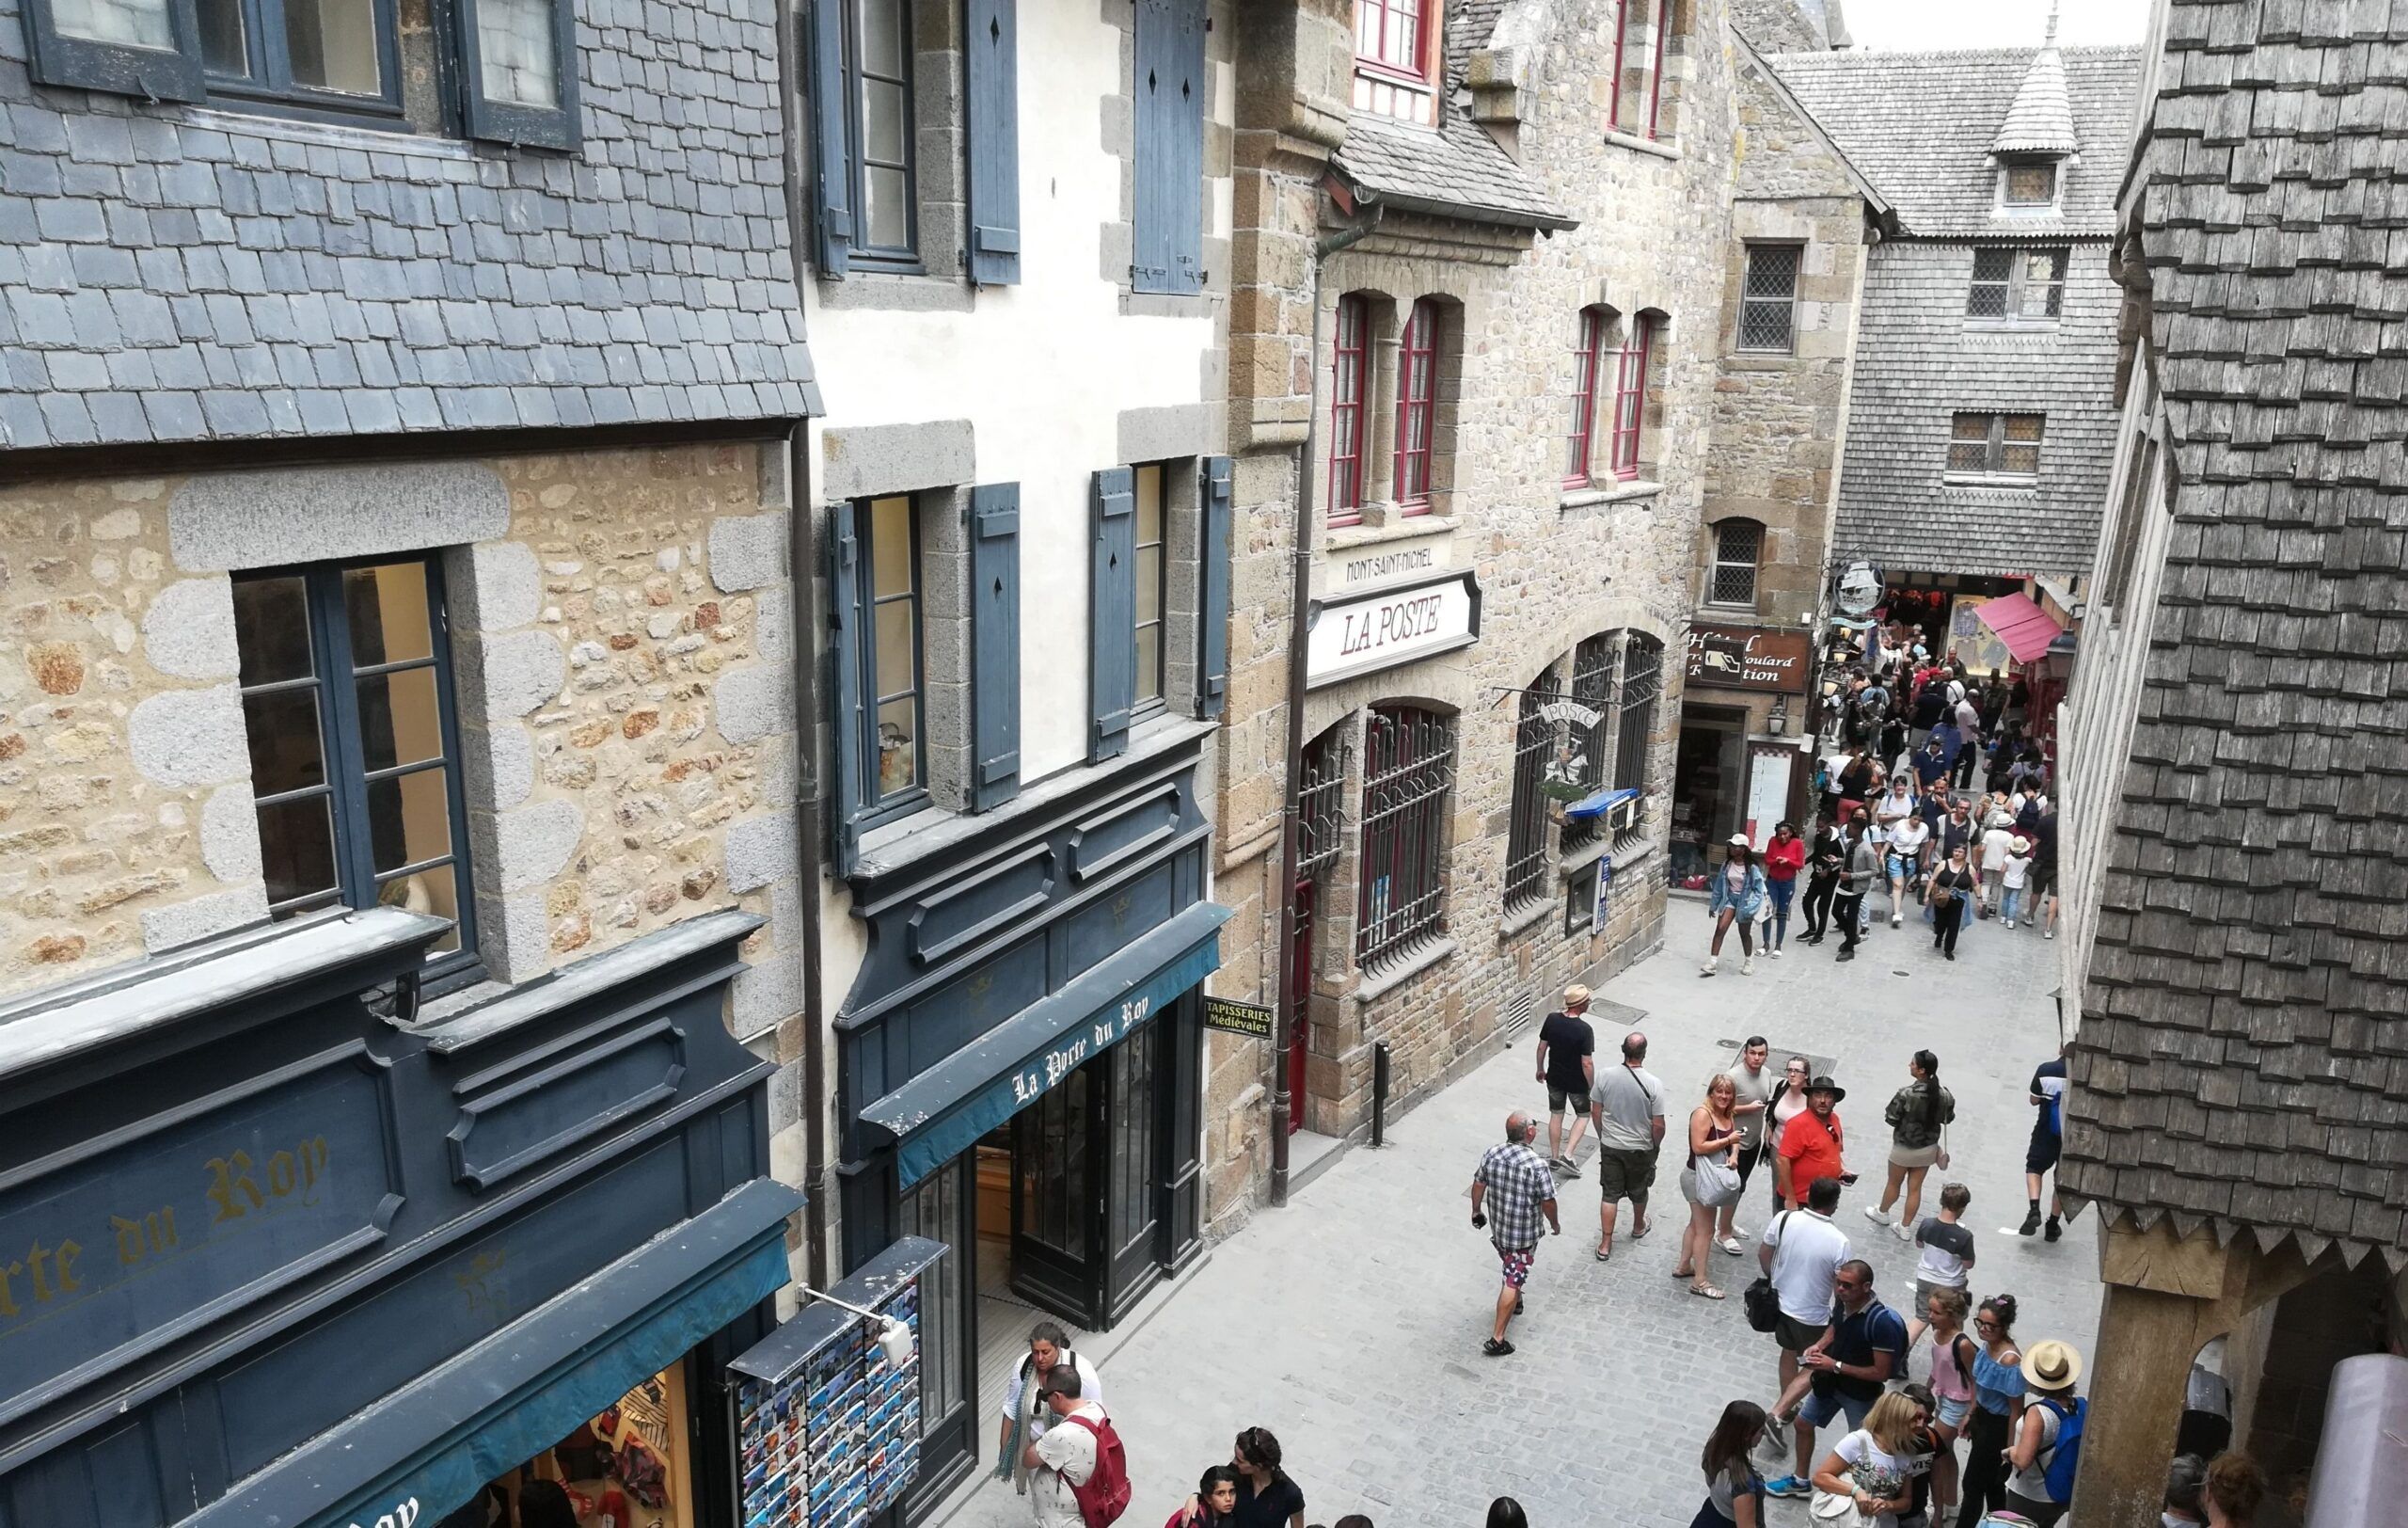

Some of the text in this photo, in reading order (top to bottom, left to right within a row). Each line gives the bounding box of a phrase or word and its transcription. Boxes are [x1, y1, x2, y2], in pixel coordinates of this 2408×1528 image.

[1340, 594, 1442, 656] LA POSTE
[1743, 655, 1797, 667] oulard
[1689, 664, 1780, 682] Rtion
[1547, 703, 1596, 726] POSTE
[1206, 1001, 1271, 1022] TAPISSERIES
[1210, 1013, 1267, 1033] Médiévales
[1012, 995, 1149, 1106] La Porte du Roy
[0, 1133, 327, 1316] rte du Roy
